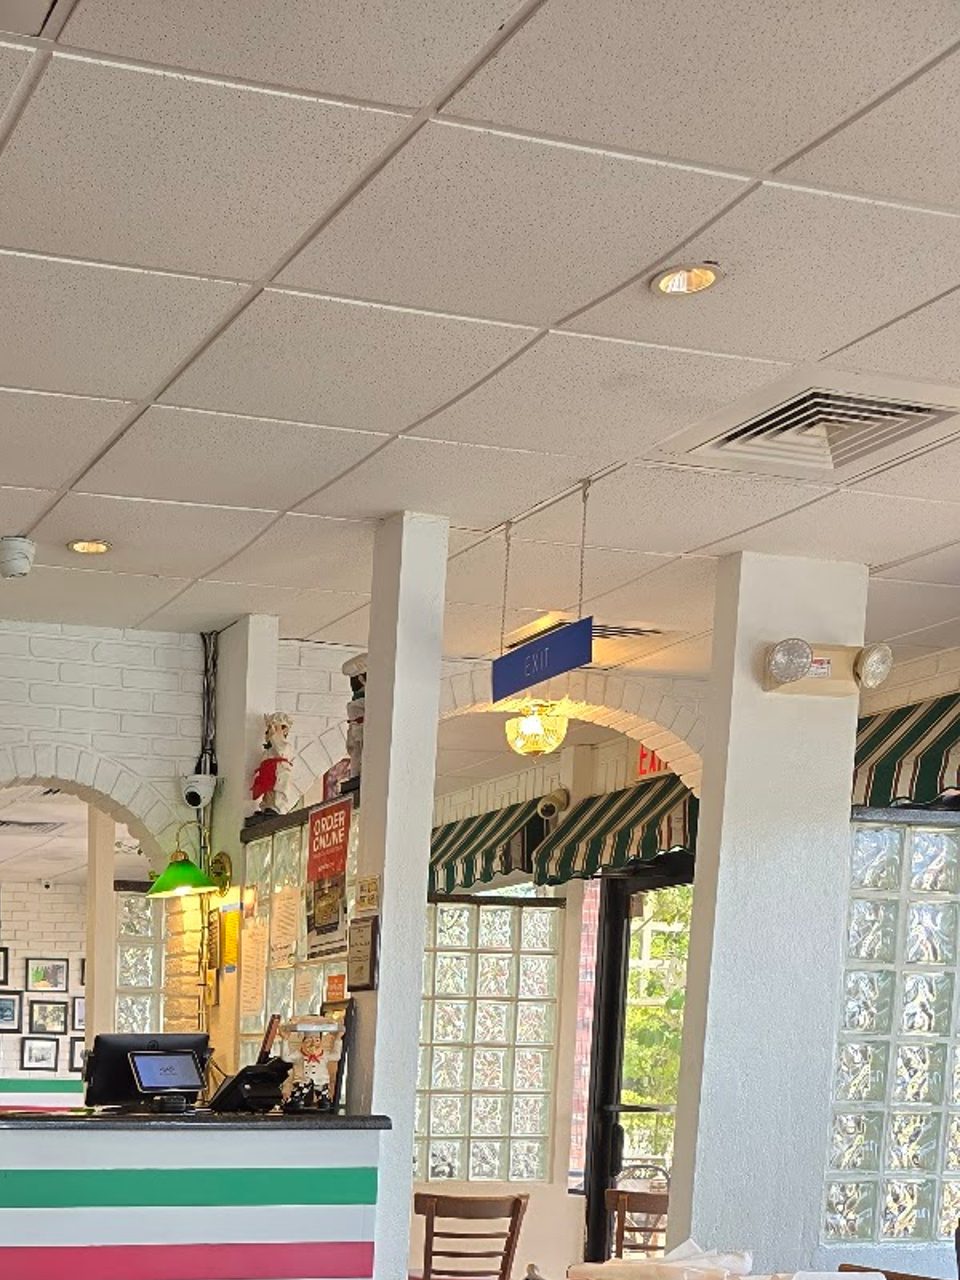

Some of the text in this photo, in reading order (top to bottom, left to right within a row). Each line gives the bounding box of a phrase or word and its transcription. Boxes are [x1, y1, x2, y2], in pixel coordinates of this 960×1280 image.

[525, 646, 550, 677] EXIT
[639, 743, 669, 775] EX
[313, 810, 346, 836] ORDER
[313, 827, 346, 853] ONLINE
